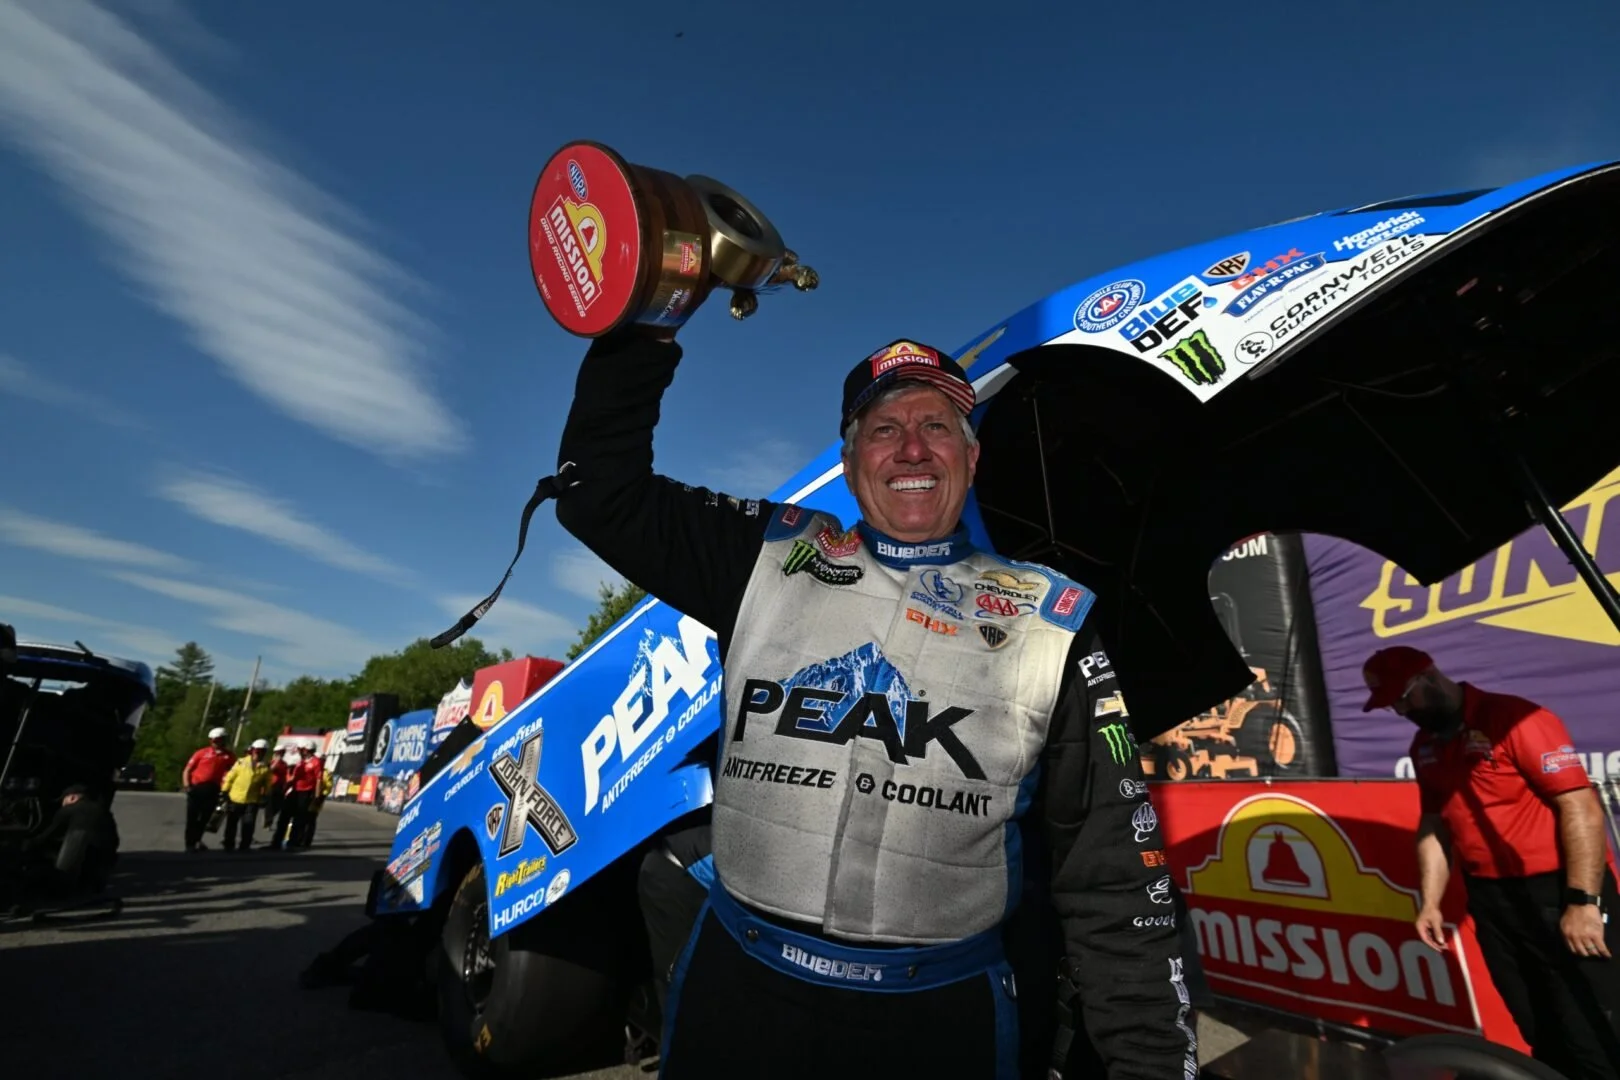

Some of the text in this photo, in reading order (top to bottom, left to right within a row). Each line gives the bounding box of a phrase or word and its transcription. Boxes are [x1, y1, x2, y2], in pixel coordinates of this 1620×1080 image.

[569, 165, 586, 198] NHRA
[1333, 211, 1420, 251] Hendrick
[540, 217, 587, 318] DRAG RACING SERIES
[1230, 248, 1305, 290] GHX
[1270, 234, 1416, 332] CORNWELL
[1093, 293, 1125, 316] AAA
[1275, 283, 1350, 341] QUALITY
[1359, 240, 1425, 281] TOOLS
[1130, 290, 1203, 353] DEF
[974, 582, 1039, 603] CHEVROLET
[979, 594, 1016, 616] AAA
[906, 608, 958, 636] GHX
[395, 724, 427, 743] CAMPING
[492, 717, 543, 761] GOODYEAR
[732, 678, 988, 781] PEAK
[392, 741, 425, 763] WORLD
[444, 759, 485, 801] CHEVROLET
[601, 735, 664, 814] ANTIFREEZE
[722, 757, 836, 789] ANTIFREEZE
[881, 779, 992, 816] COOLANT
[499, 759, 532, 798] JOHN
[526, 789, 567, 842] FORCE
[494, 887, 545, 931] HURCO
